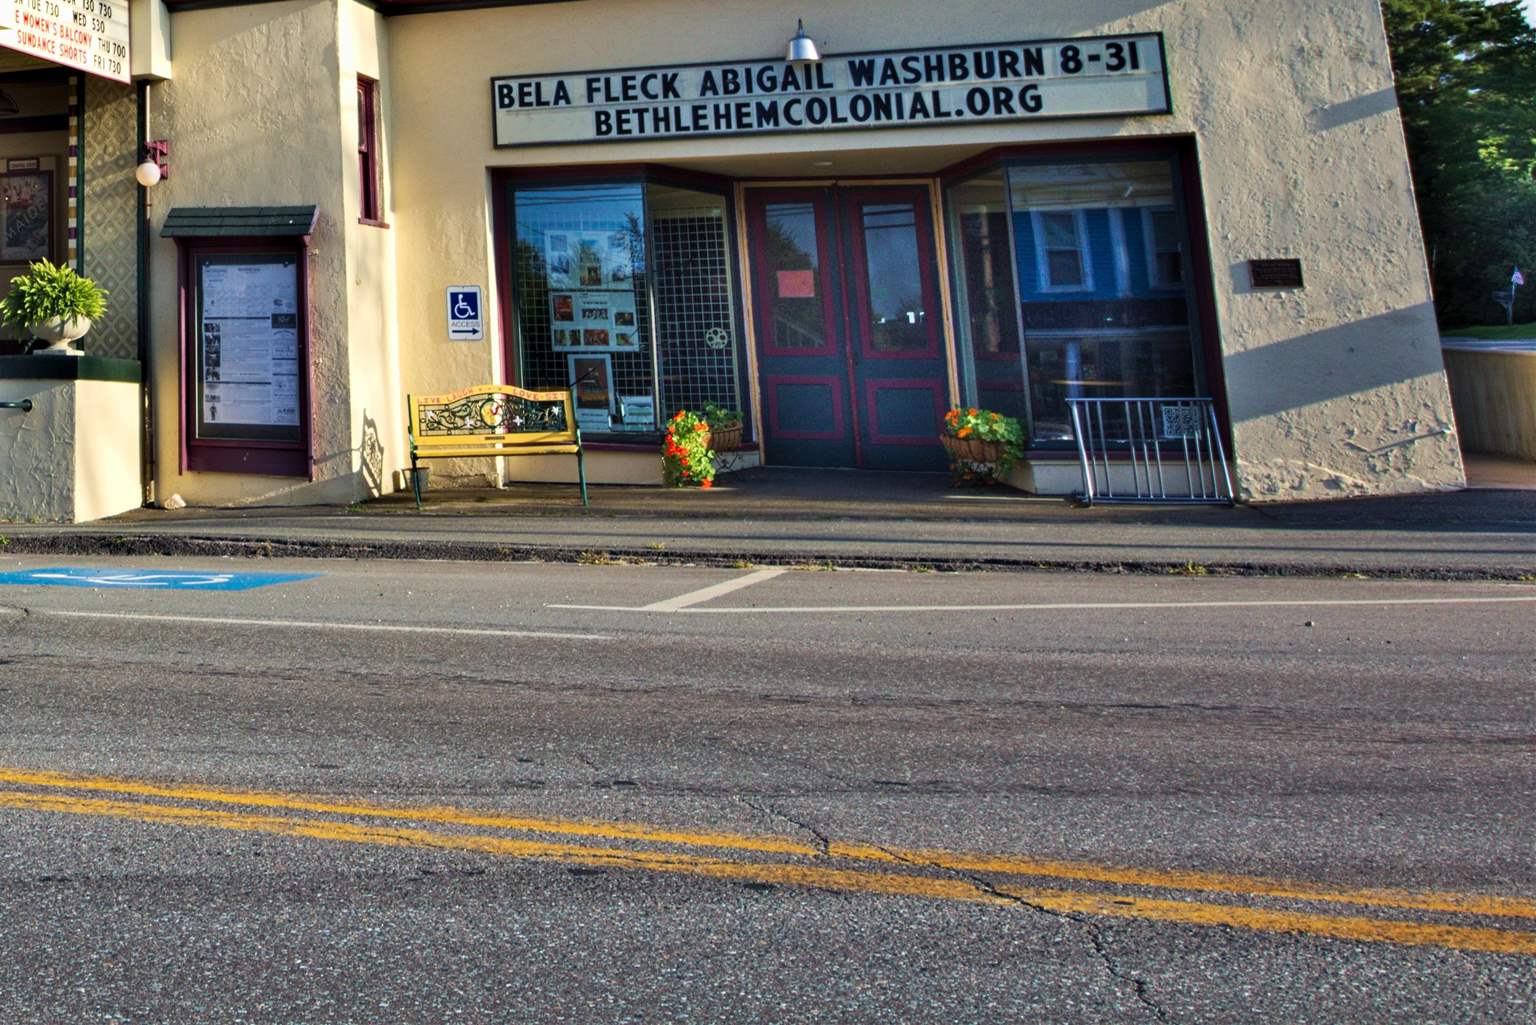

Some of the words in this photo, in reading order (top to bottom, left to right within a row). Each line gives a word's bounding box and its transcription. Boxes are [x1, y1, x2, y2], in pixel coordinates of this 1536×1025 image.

[45, 0, 60, 18] 730
[72, 10, 87, 27] WED
[92, 17, 105, 34] 530
[98, 2, 113, 19] 730
[17, 29, 55, 55] SUNDANCE
[59, 43, 88, 64] SHORTS
[93, 54, 105, 70] FRI
[108, 59, 122, 75] 730
[22, 11, 57, 36] WOMEN'S
[59, 24, 93, 48] BALCONY
[98, 37, 111, 53] THU
[112, 42, 126, 59] 700
[497, 78, 571, 110] BELA
[585, 72, 682, 105] FLECK
[699, 63, 834, 97] ABIGAIL
[848, 46, 1045, 89] WASHBURN
[1059, 44, 1140, 75] 8-31
[594, 84, 1043, 138] BETHLEHEMCOLONIAL.ORG
